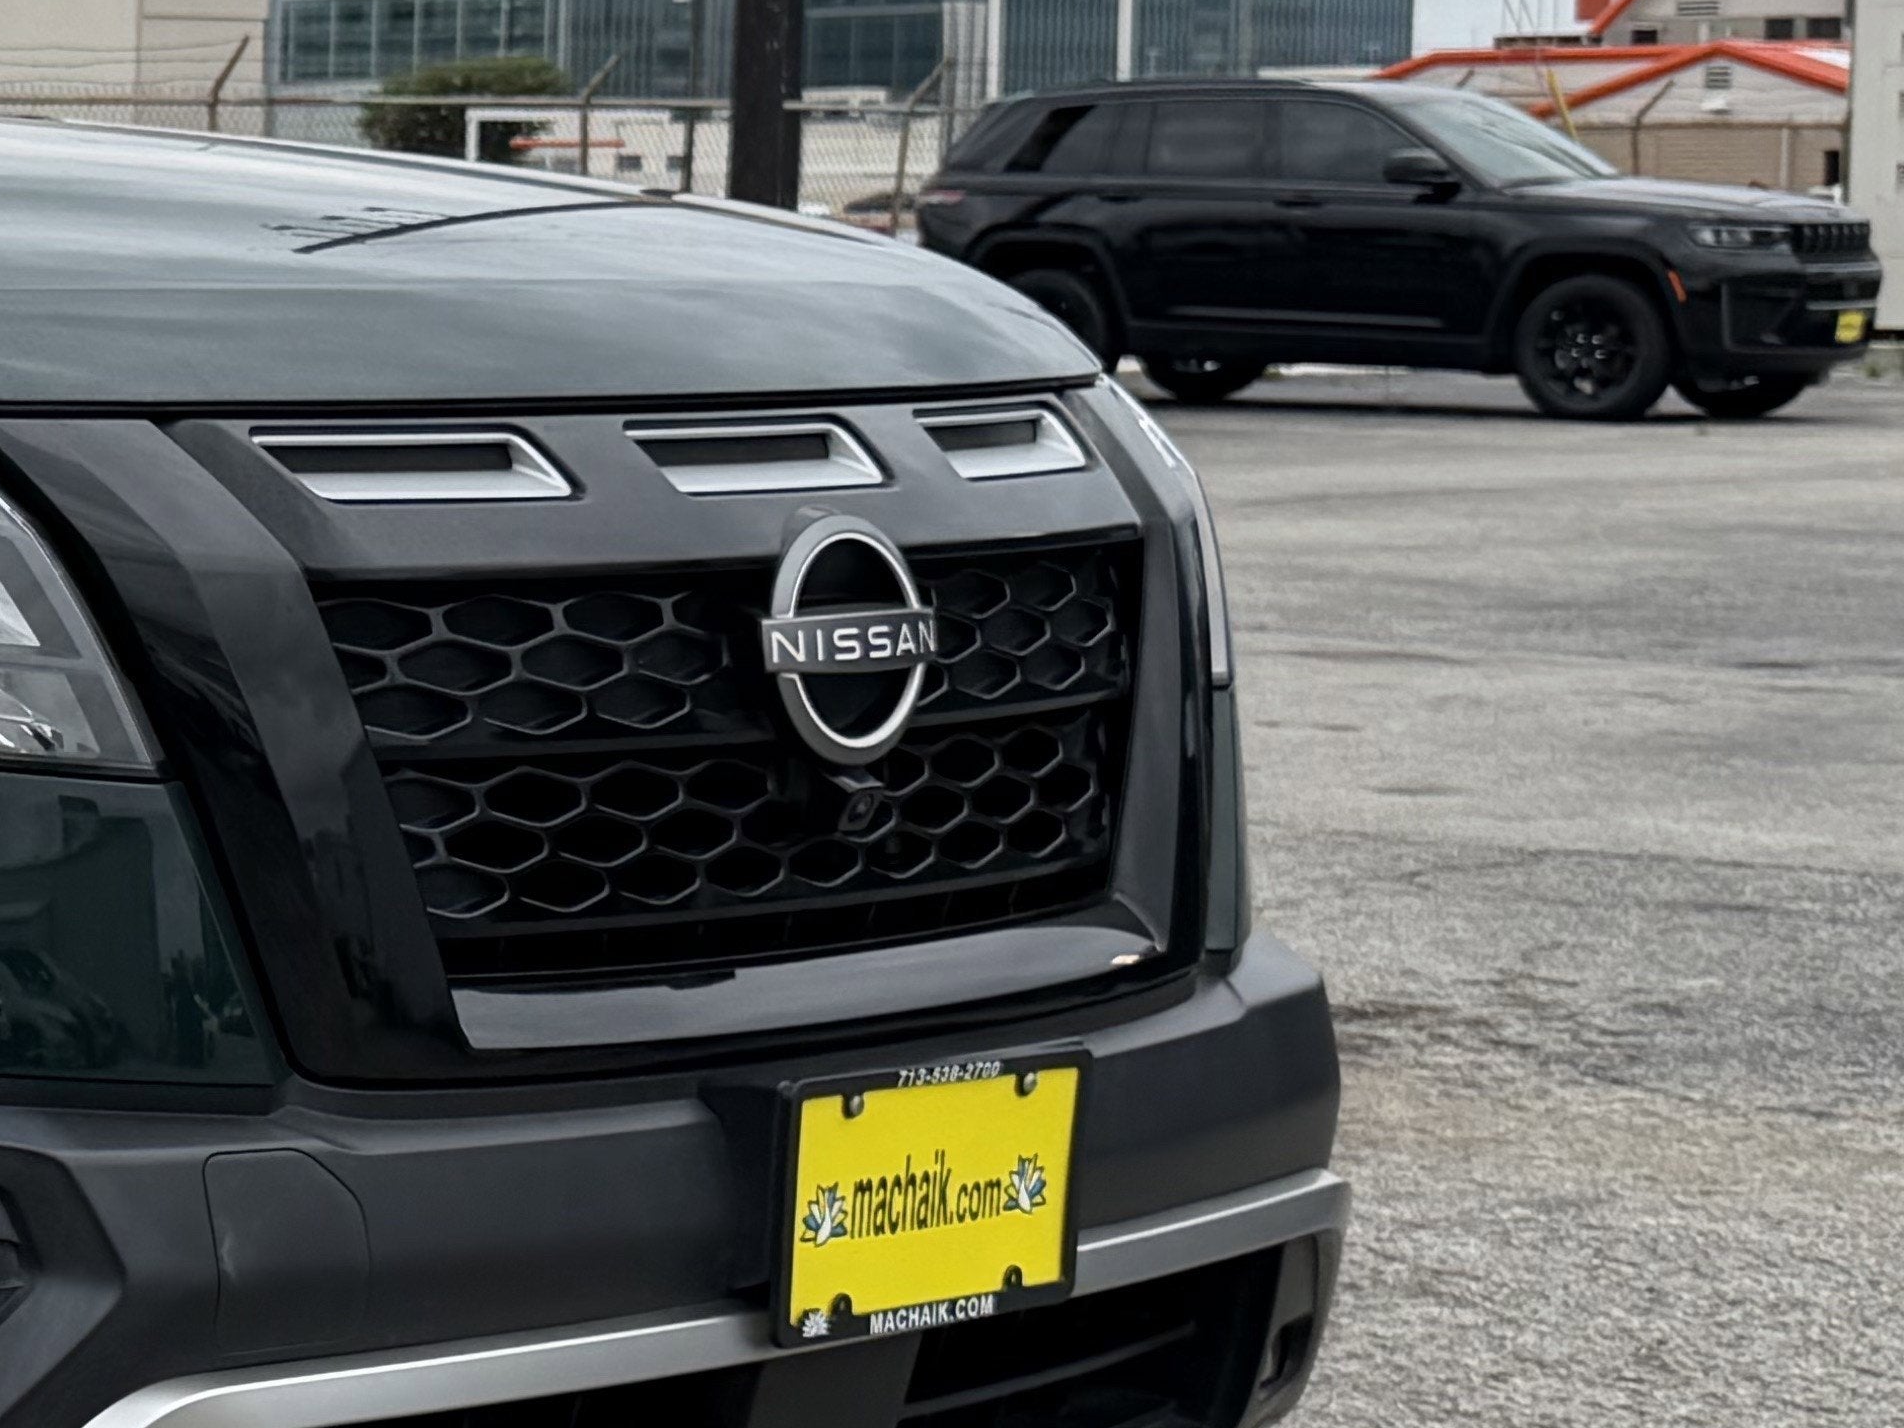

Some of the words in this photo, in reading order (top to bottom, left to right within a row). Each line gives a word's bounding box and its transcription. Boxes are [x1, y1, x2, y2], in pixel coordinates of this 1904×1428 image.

[771, 620, 935, 663] NISSAN
[850, 1148, 1002, 1239] machaik.com
[869, 1294, 994, 1335] MACHAIK.COM
